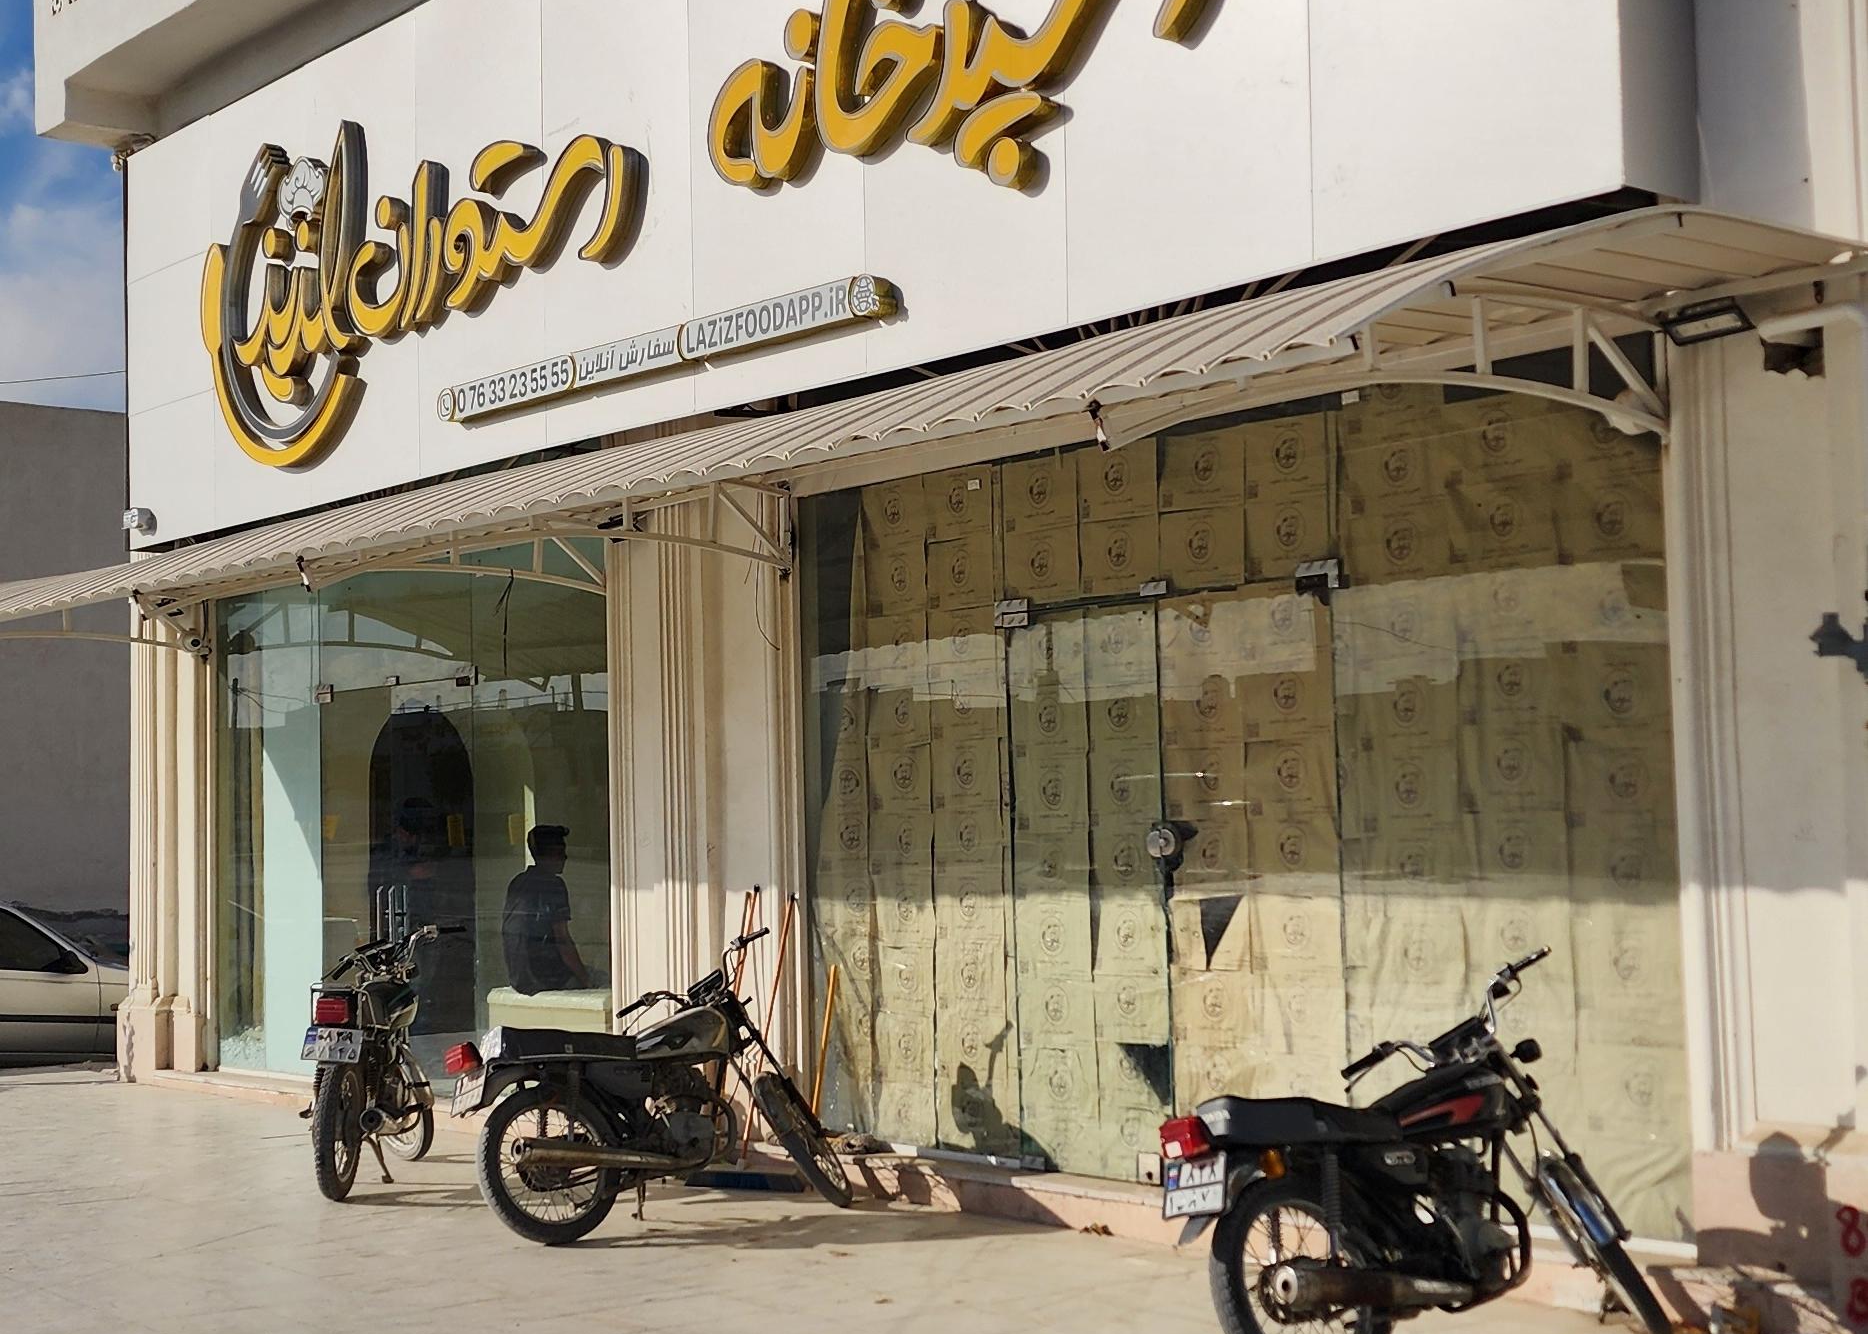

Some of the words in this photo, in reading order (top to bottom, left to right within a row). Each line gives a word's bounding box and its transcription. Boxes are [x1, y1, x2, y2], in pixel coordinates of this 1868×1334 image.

[347, 134, 650, 345] رستوران
[578, 345, 616, 382] آنلاین
[619, 338, 676, 372] سفارش
[469, 383, 485, 411] 76
[488, 378, 506, 405] 33
[509, 371, 528, 400] 23
[530, 364, 548, 394] 55
[551, 358, 569, 388] 55
